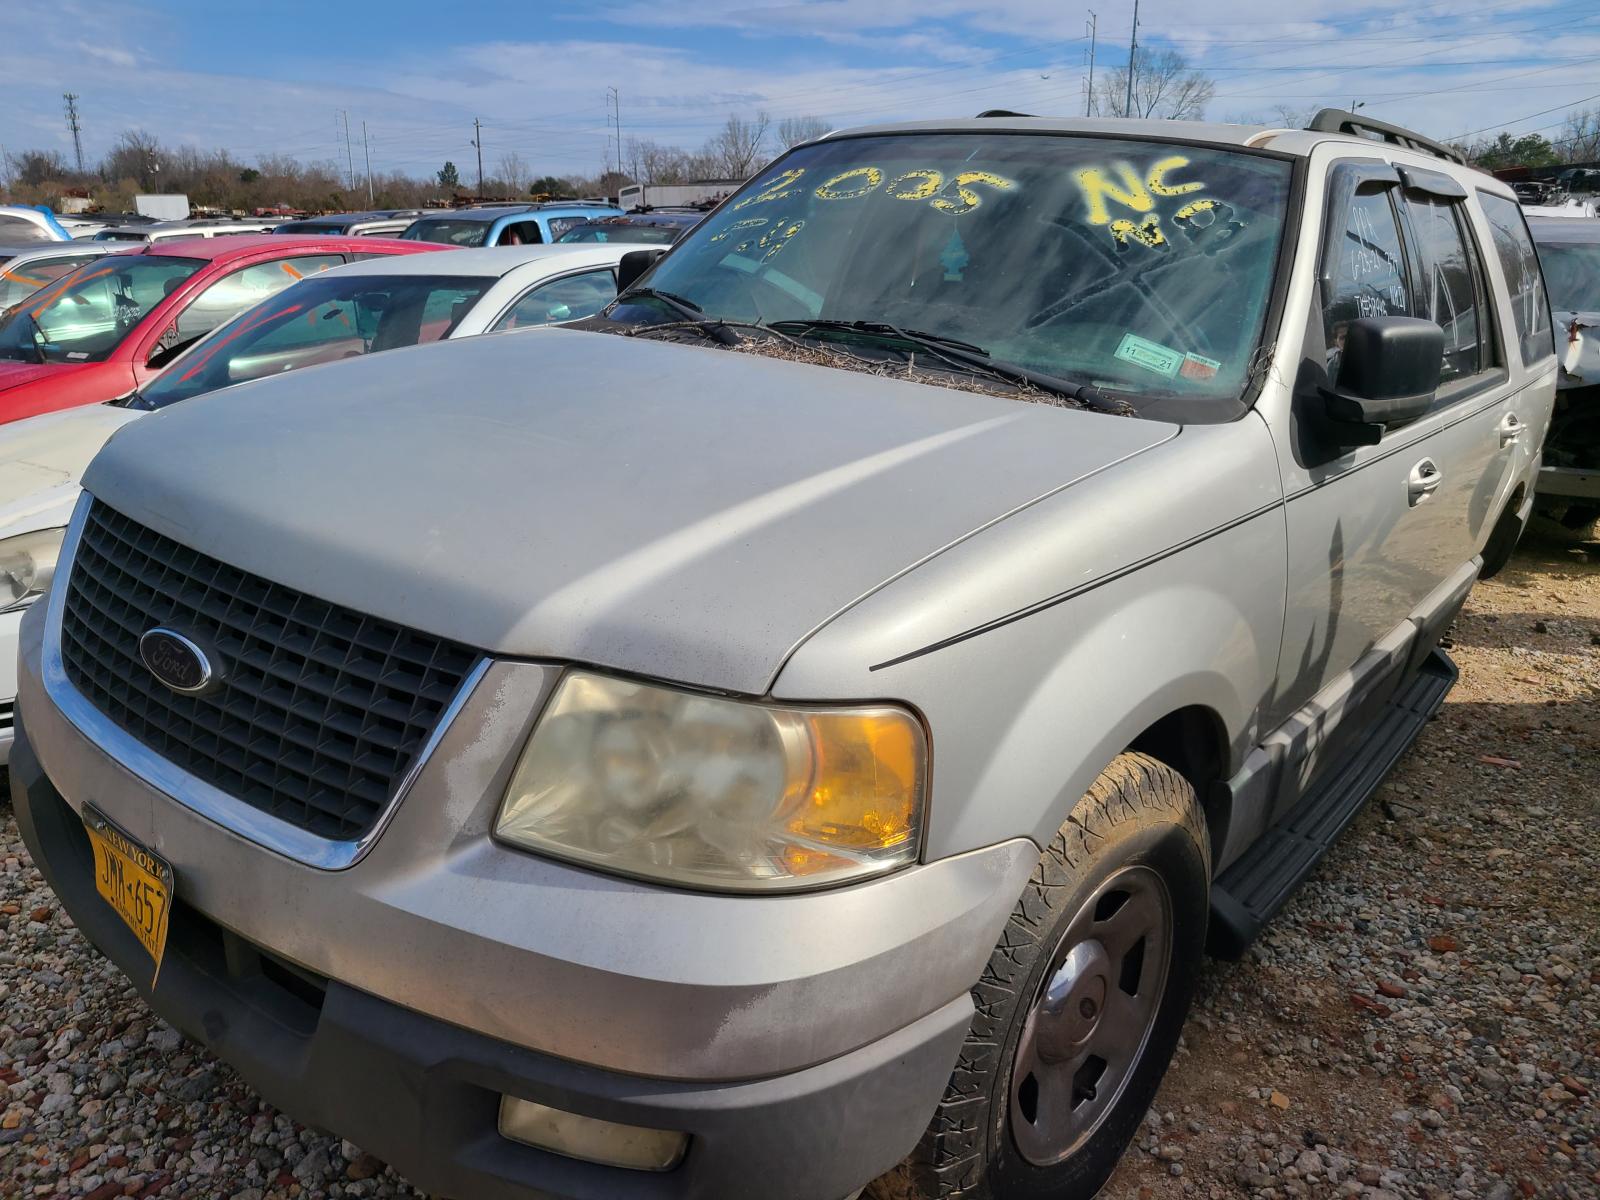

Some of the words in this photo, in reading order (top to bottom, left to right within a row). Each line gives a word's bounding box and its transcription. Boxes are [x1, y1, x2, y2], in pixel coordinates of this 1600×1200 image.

[731, 168, 1016, 216] 2005
[1076, 155, 1206, 225] NC
[1159, 359, 1172, 370] 21
[152, 640, 192, 680] Ford
[105, 826, 129, 854] NEW
[131, 846, 164, 880] YORK
